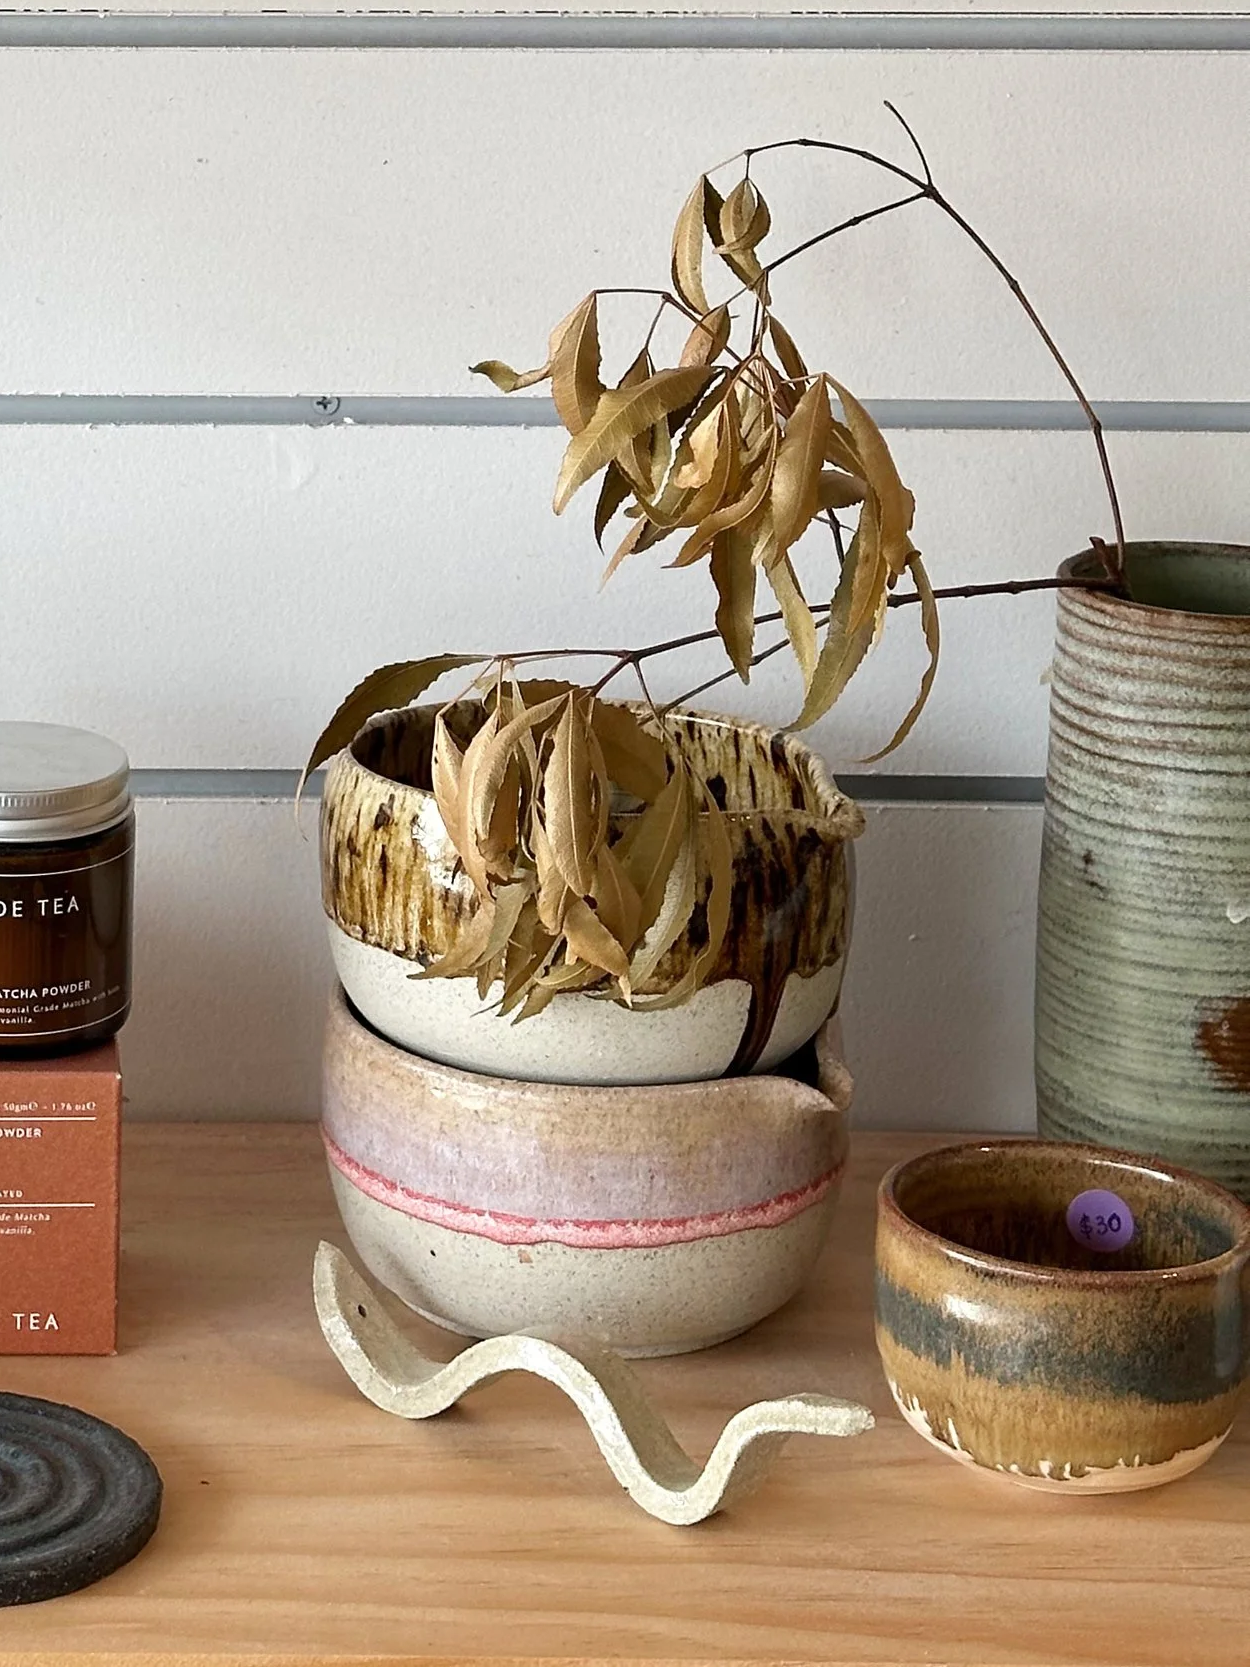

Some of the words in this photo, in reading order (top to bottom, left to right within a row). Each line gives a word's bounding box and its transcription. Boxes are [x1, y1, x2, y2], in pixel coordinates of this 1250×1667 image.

[37, 896, 79, 916] TEA
[42, 980, 91, 997] POWDER
[33, 1004, 59, 1013] Grade
[62, 998, 90, 1009] Matcha
[14, 1213, 51, 1222] Matcha
[1079, 1212, 1122, 1240] $30
[12, 1313, 59, 1331] TEA
